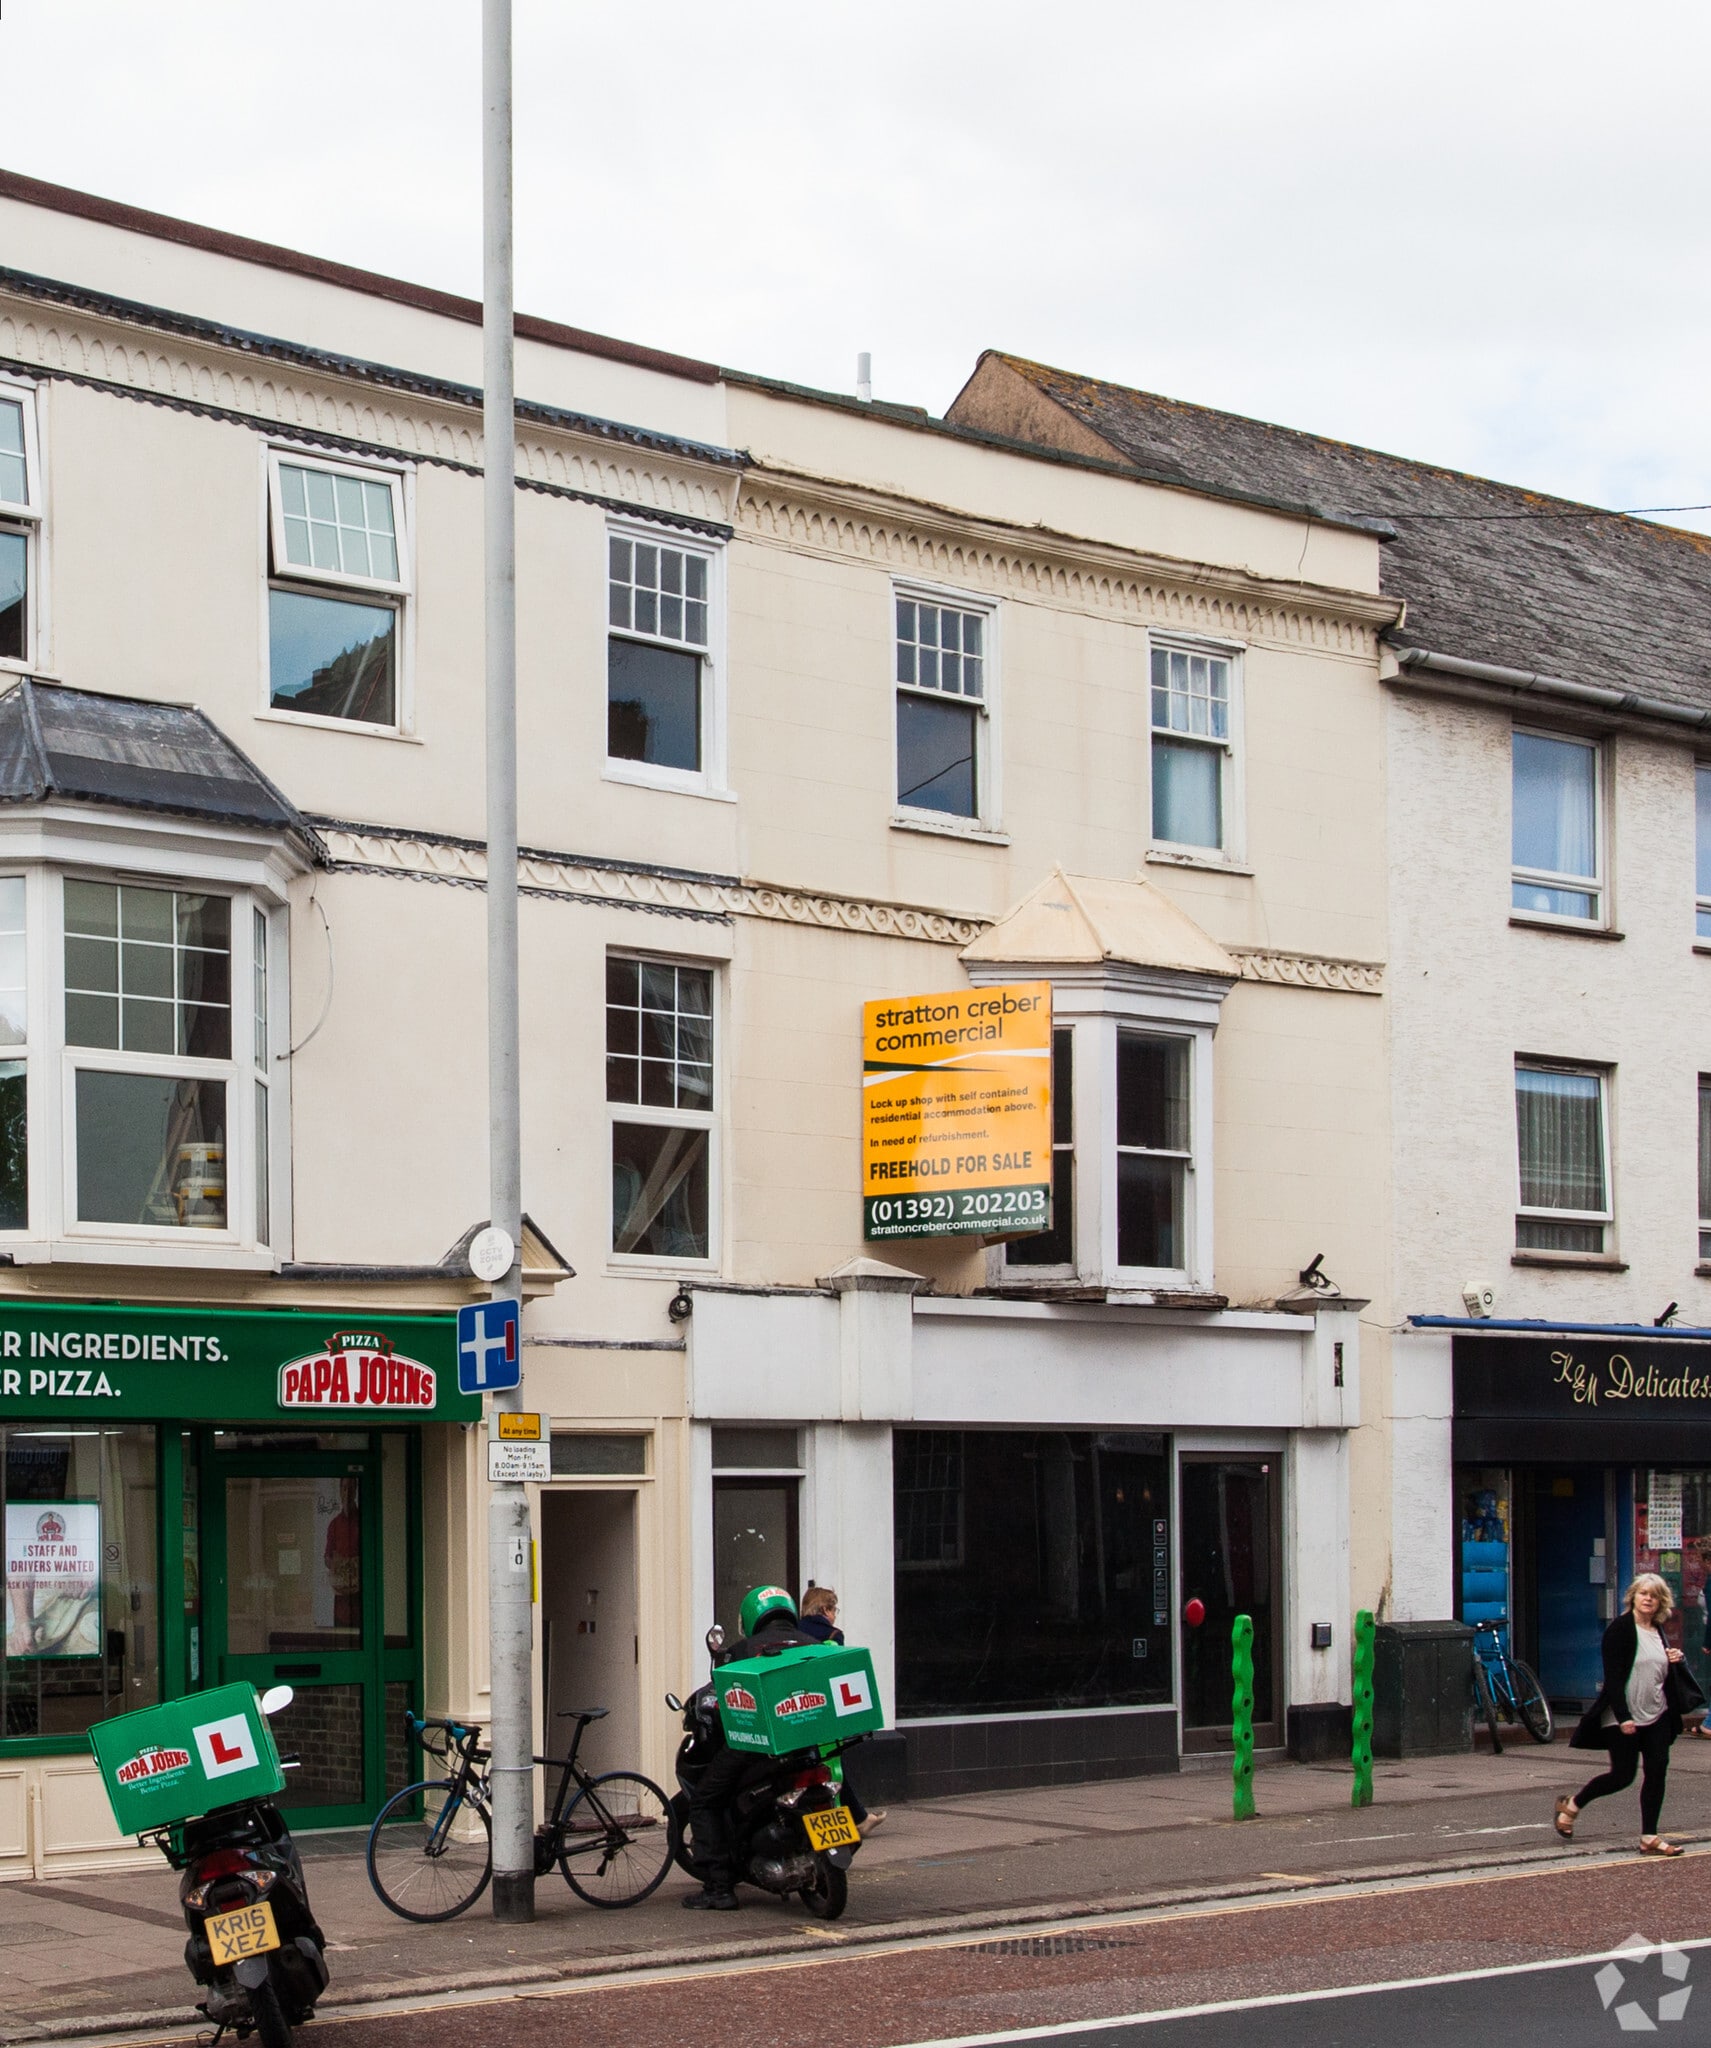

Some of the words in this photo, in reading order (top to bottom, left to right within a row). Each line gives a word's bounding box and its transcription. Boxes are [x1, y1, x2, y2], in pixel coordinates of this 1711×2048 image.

[875, 1003, 960, 1028] stratton
[967, 993, 1042, 1018] creber
[875, 1017, 1003, 1052] commercial
[870, 1100, 893, 1109] Lock
[895, 1100, 908, 1108] up
[910, 1095, 933, 1106] shop
[935, 1093, 956, 1103] with
[959, 1091, 977, 1101] self
[979, 1086, 1029, 1099] contained
[870, 1111, 921, 1124] residential
[923, 1105, 1001, 1119] accommodation
[1004, 1102, 1037, 1112] above.
[870, 1138, 879, 1148] In
[881, 1137, 904, 1147] need
[907, 1135, 917, 1145] of
[919, 1129, 990, 1144] refurbishment.
[870, 1157, 951, 1180] FREEHOLD
[956, 1155, 987, 1174] FOR
[992, 1151, 1032, 1171] SALE
[871, 1195, 954, 1224] (01392)
[961, 1190, 1046, 1215] 202203
[871, 1214, 1046, 1235] strattoncrebercommercial.co.uk
[0, 1331, 21, 1357] R
[30, 1331, 229, 1362] INGREDIENTS.
[341, 1335, 380, 1348] PIZZA
[0, 1369, 21, 1395] R
[30, 1369, 121, 1396] PIZZA.
[286, 1356, 350, 1402] PAPA
[1604, 1354, 1711, 1398] Delicates
[513, 1446, 536, 1454] loading
[27, 1545, 57, 1557] STAFF
[59, 1545, 78, 1557] AND
[11, 1560, 51, 1573] DRIVERS
[54, 1560, 94, 1573] WANTED
[776, 1697, 798, 1715] PAPA
[840, 1683, 861, 1707] L
[209, 1732, 243, 1765] L
[119, 1757, 150, 1783] PAPA
[809, 1811, 849, 1831] KR16
[817, 1825, 852, 1846] XDN
[213, 1908, 266, 1939] KR16
[221, 1929, 269, 1958] XEZ
